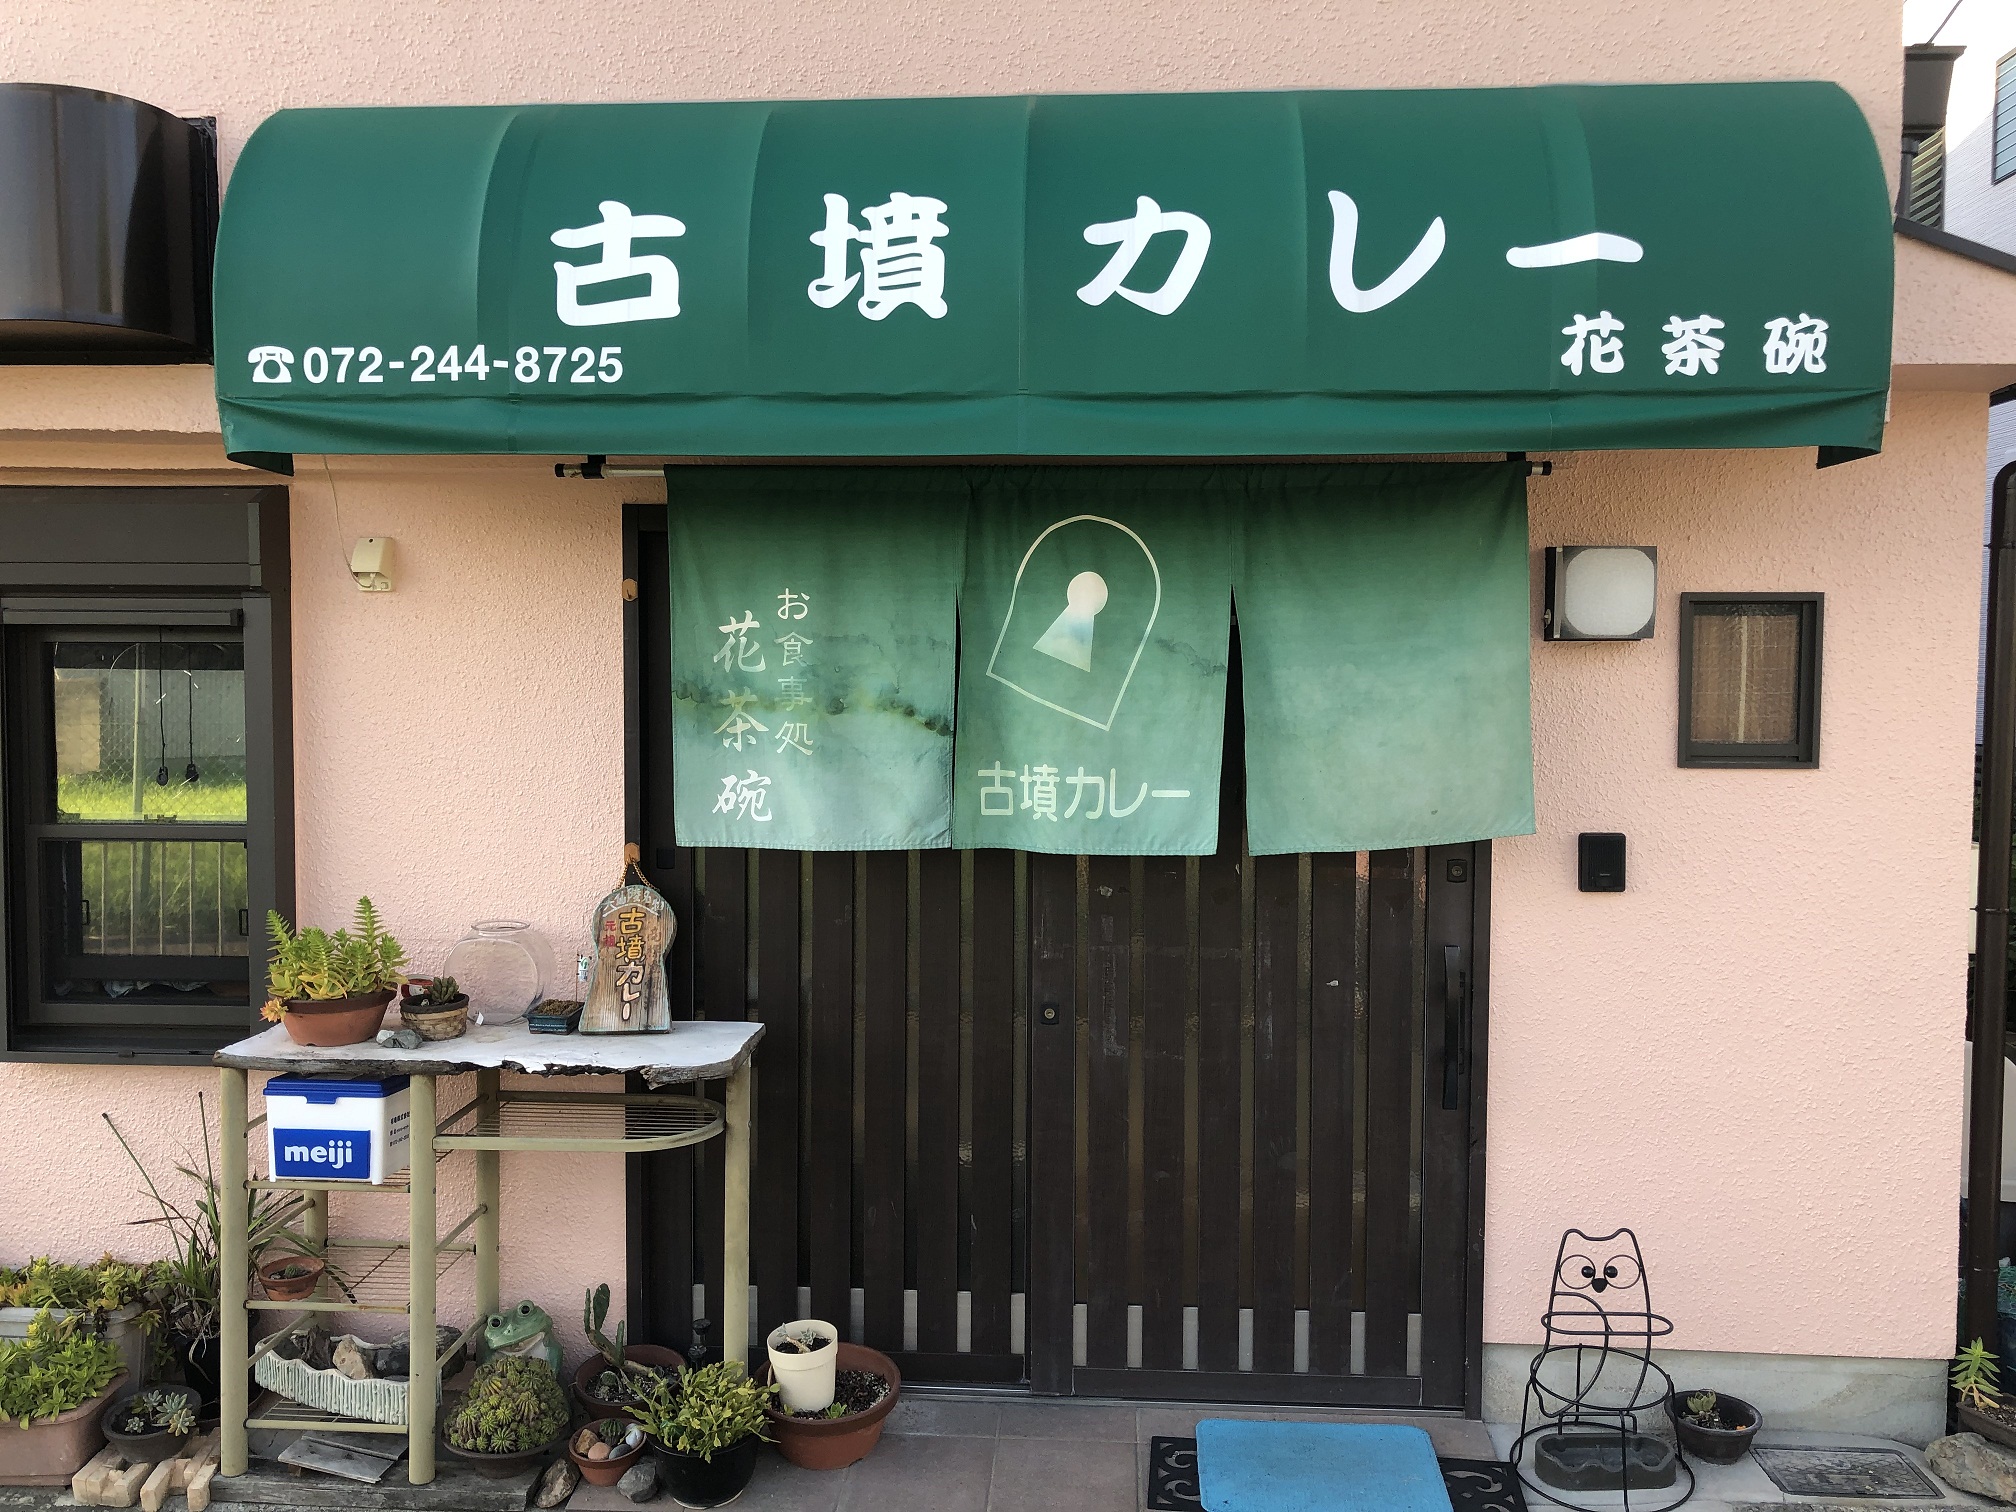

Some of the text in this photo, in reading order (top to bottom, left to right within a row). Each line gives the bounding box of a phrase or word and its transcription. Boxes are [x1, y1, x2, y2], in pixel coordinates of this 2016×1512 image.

[550, 191, 1645, 327] 古墳カレー
[303, 345, 624, 384] 072-244-8725
[1561, 311, 1830, 377] 花茶碗
[712, 610, 773, 823] 花茶碗
[774, 587, 814, 756] お食事処
[977, 760, 1191, 822] 古墳カレー
[615, 906, 646, 1021] 古墳カレー
[284, 1140, 353, 1169] meiji
